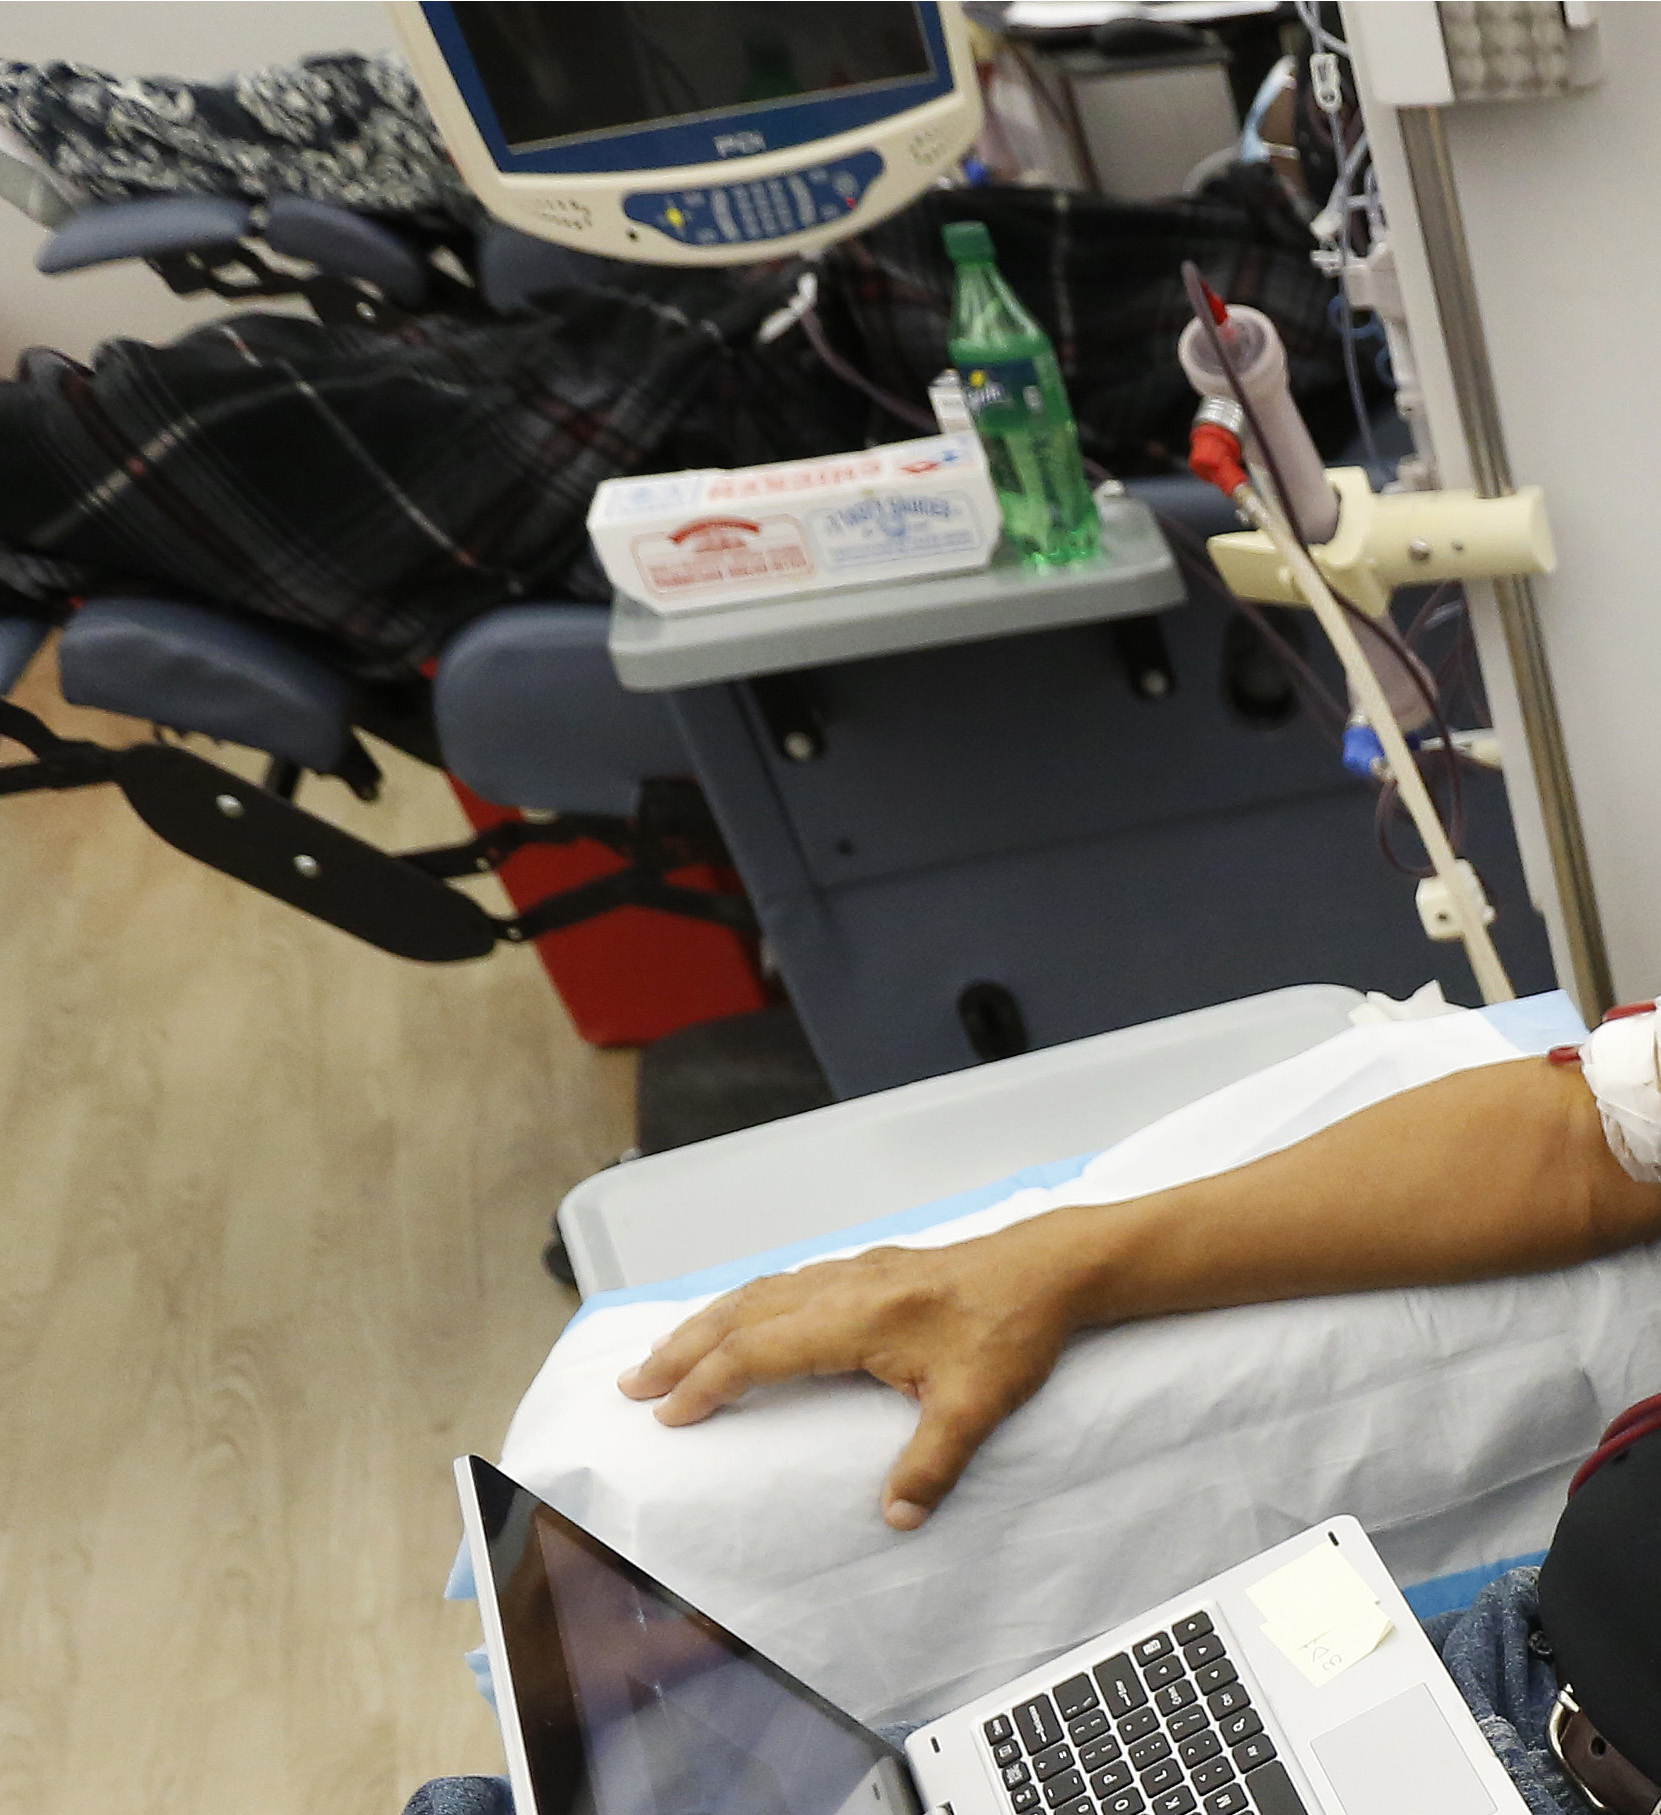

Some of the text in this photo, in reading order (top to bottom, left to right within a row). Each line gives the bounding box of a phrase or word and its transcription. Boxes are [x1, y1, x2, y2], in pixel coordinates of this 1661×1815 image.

[1102, 1773, 1119, 1786] P
[1153, 1768, 1169, 1783] L
[1164, 1795, 1181, 1811] K
[1215, 1793, 1233, 1809] M
